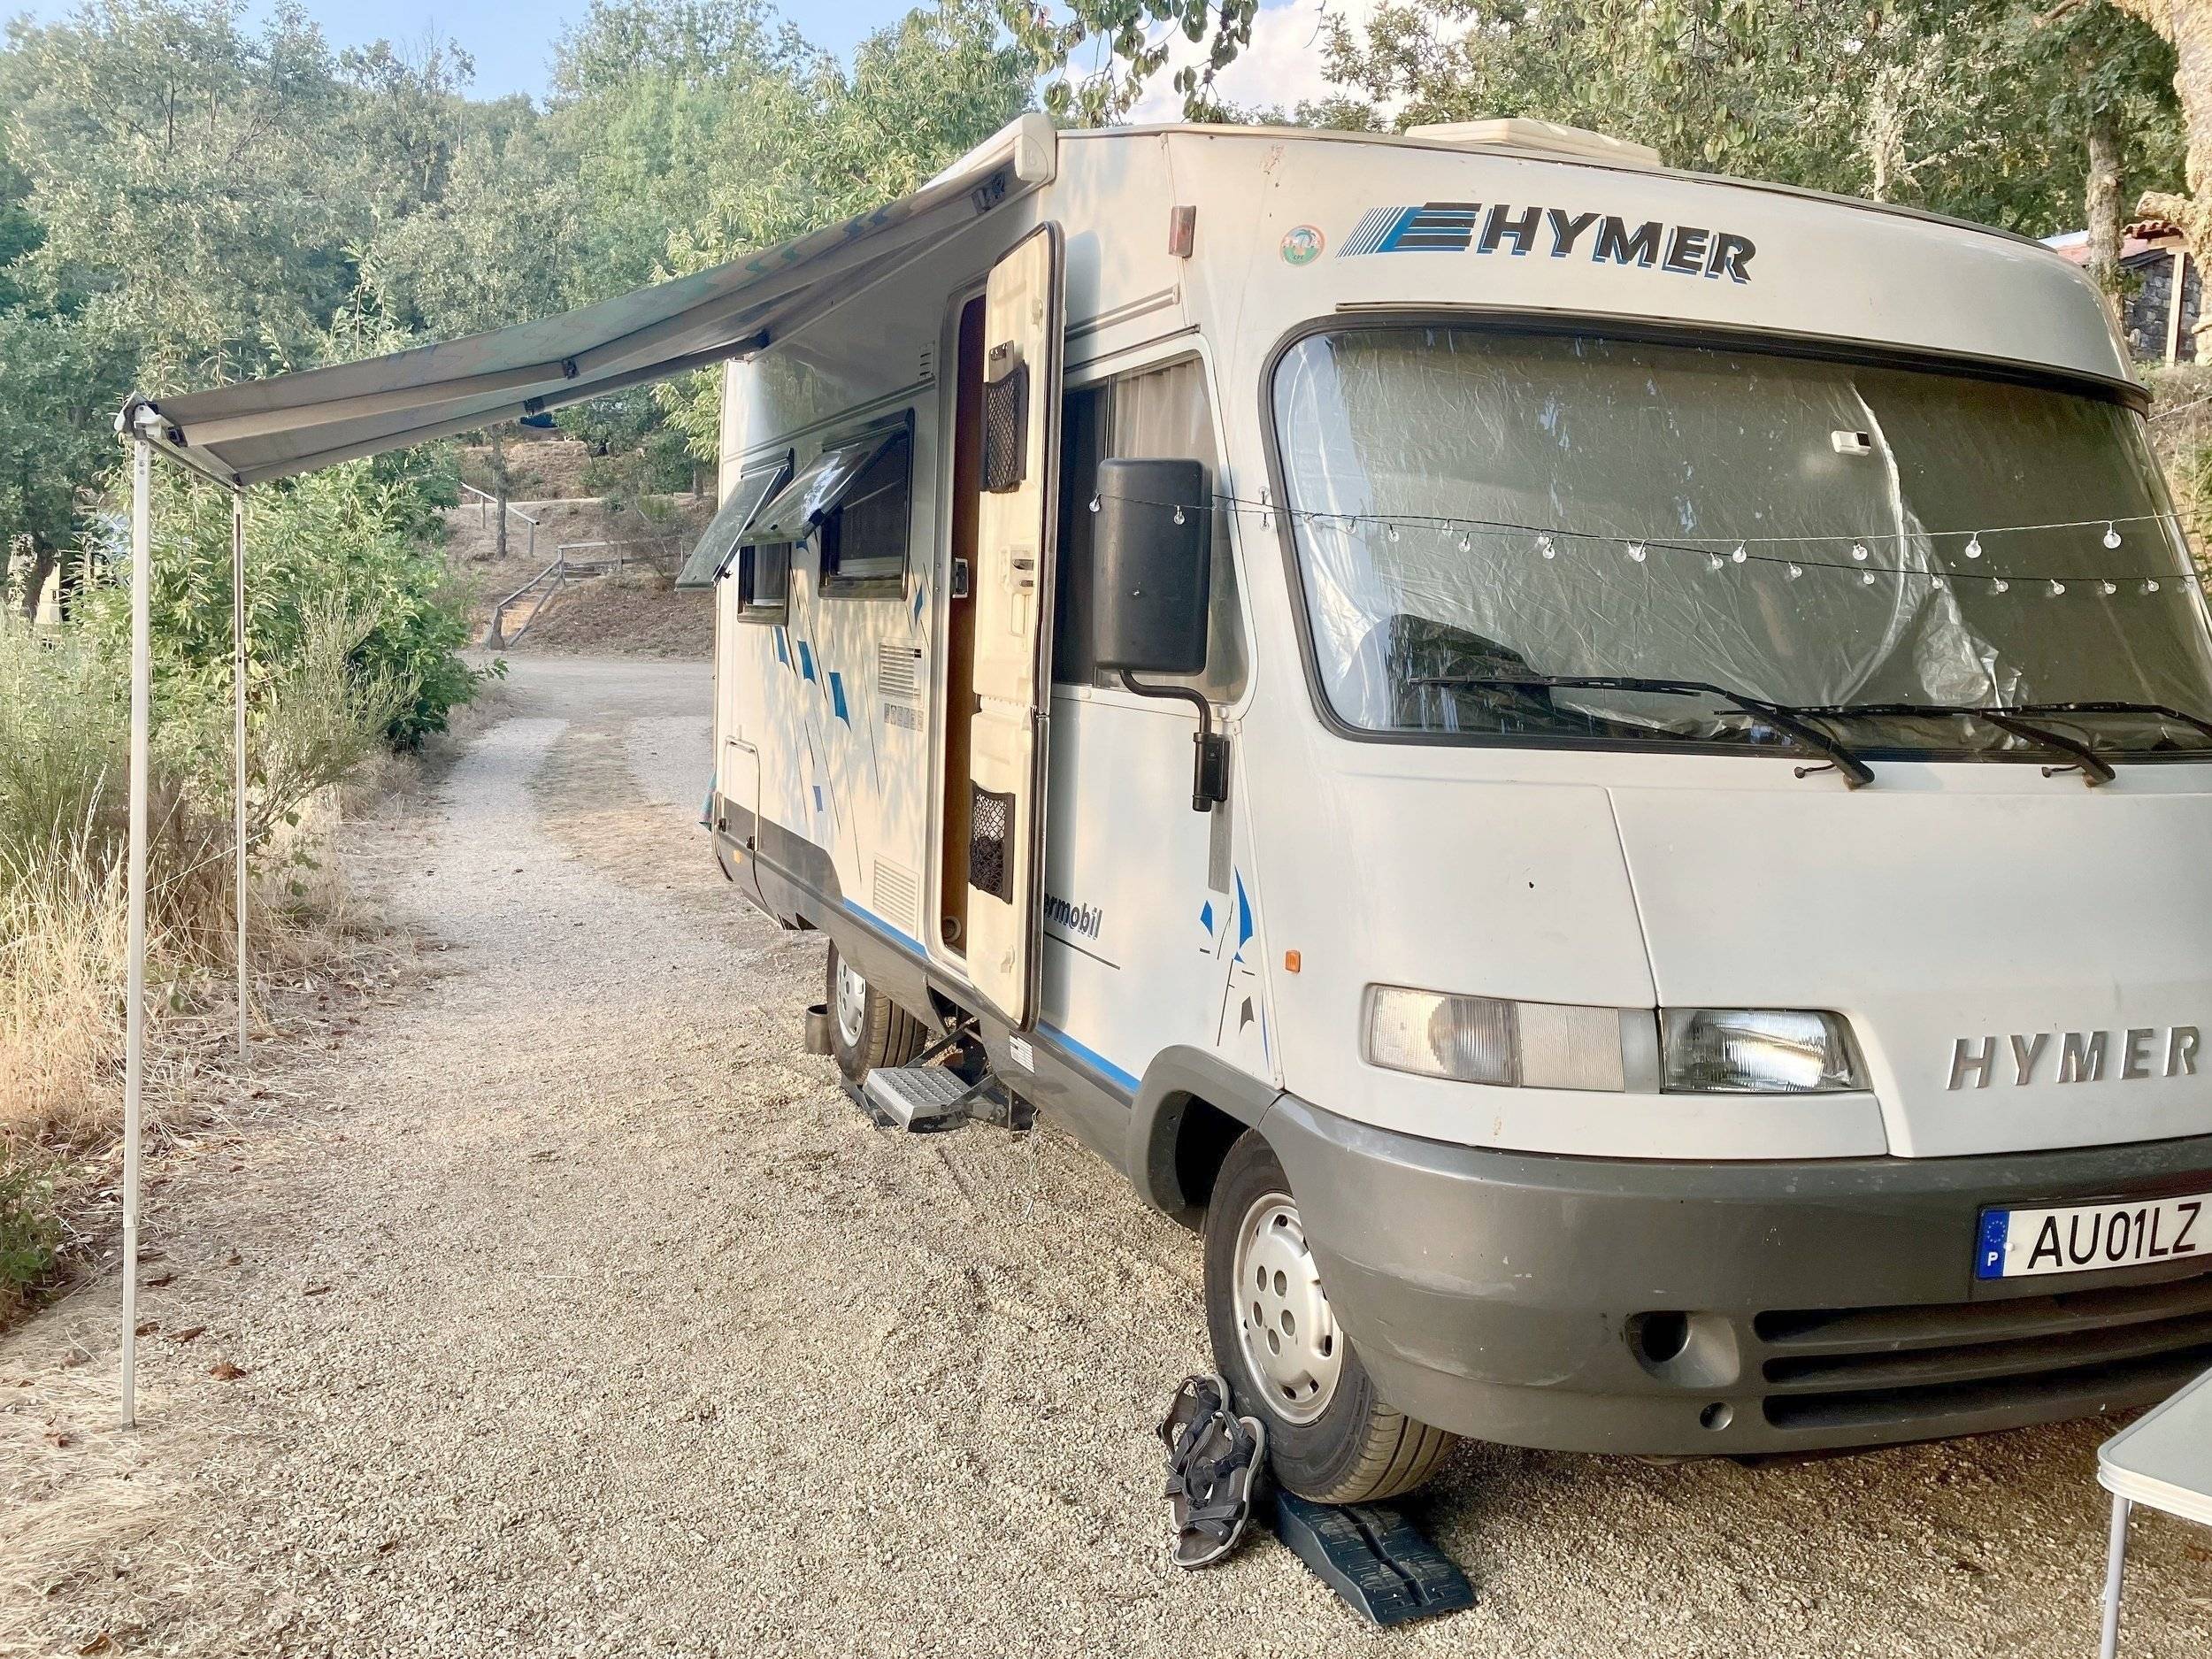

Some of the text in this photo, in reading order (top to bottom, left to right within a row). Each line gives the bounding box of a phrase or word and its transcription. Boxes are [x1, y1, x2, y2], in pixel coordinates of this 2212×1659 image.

[1476, 204, 1757, 285] HYMER
[1946, 1026, 2201, 1090] HYMER
[1987, 1252, 1999, 1267] P
